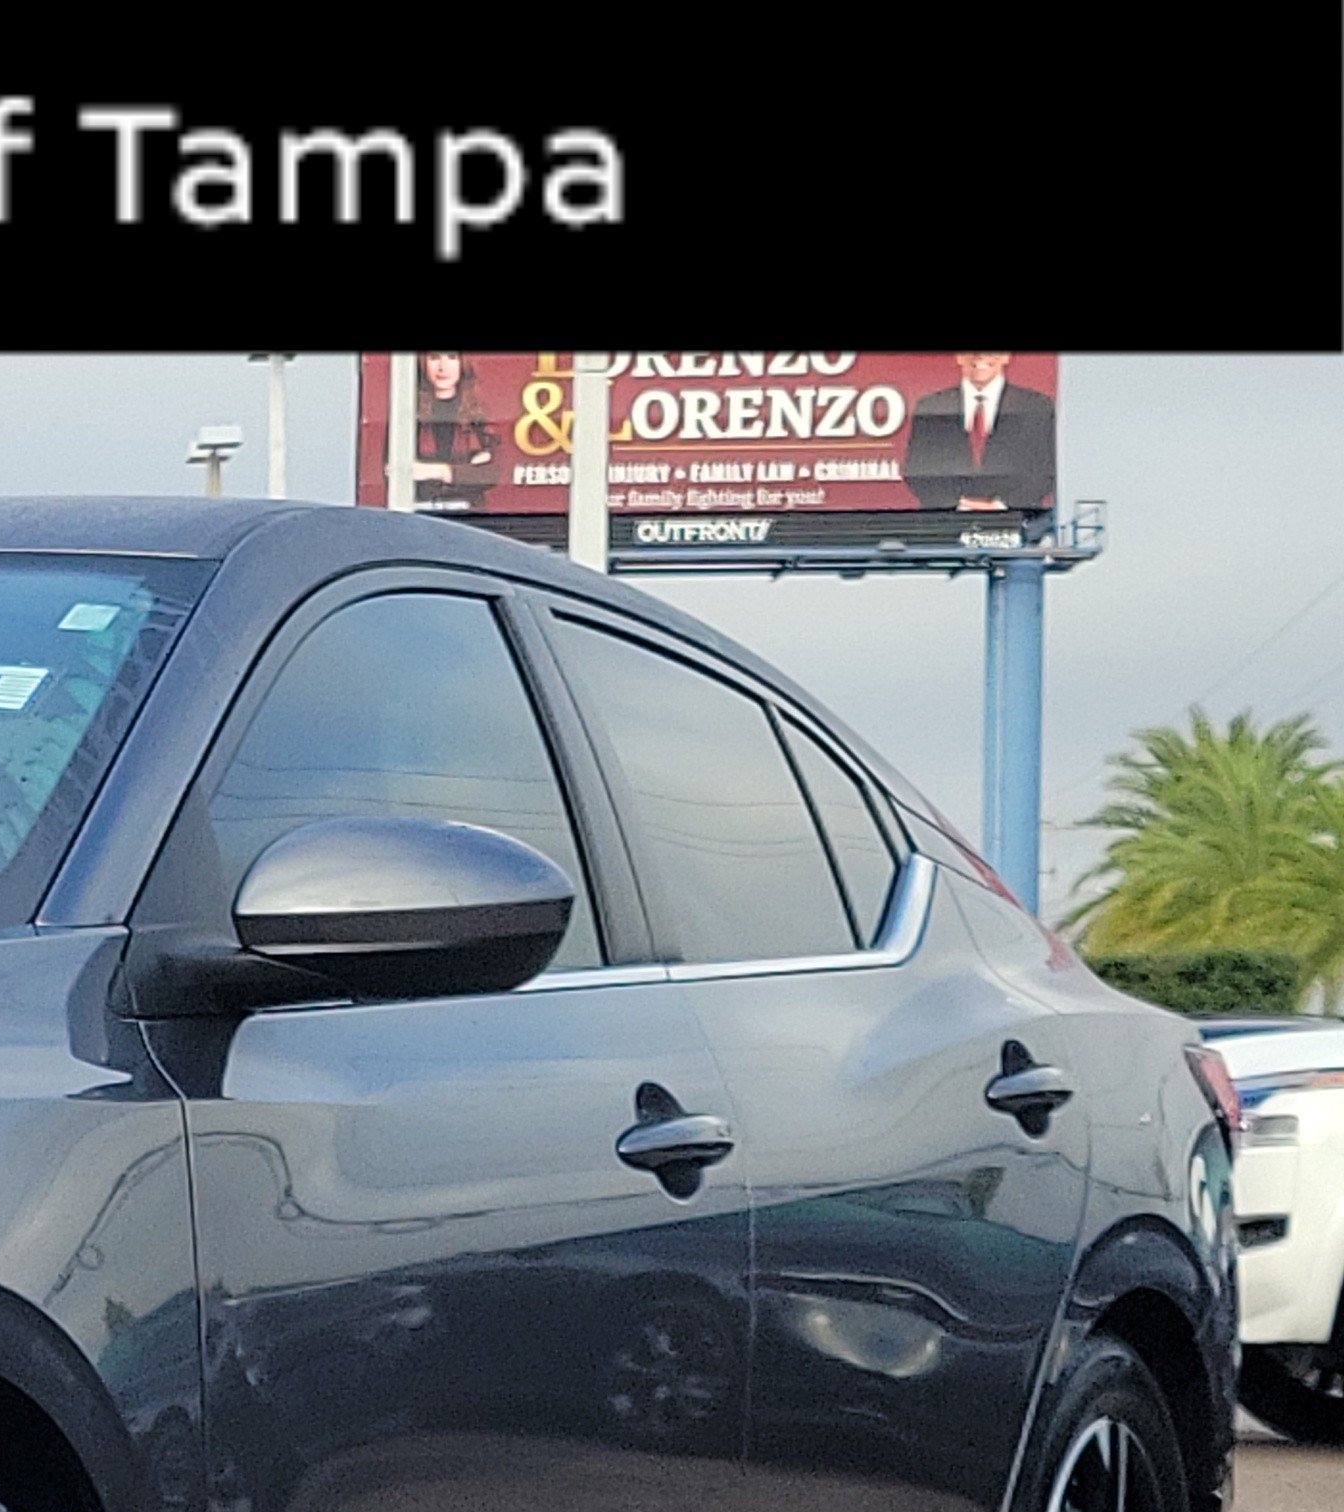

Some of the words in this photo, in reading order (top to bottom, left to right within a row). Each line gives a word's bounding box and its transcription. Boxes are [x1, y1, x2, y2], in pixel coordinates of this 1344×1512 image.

[532, 351, 856, 378] RENZO
[514, 380, 573, 456] &
[513, 463, 572, 485] PERSO
[689, 461, 754, 482] FAMILY
